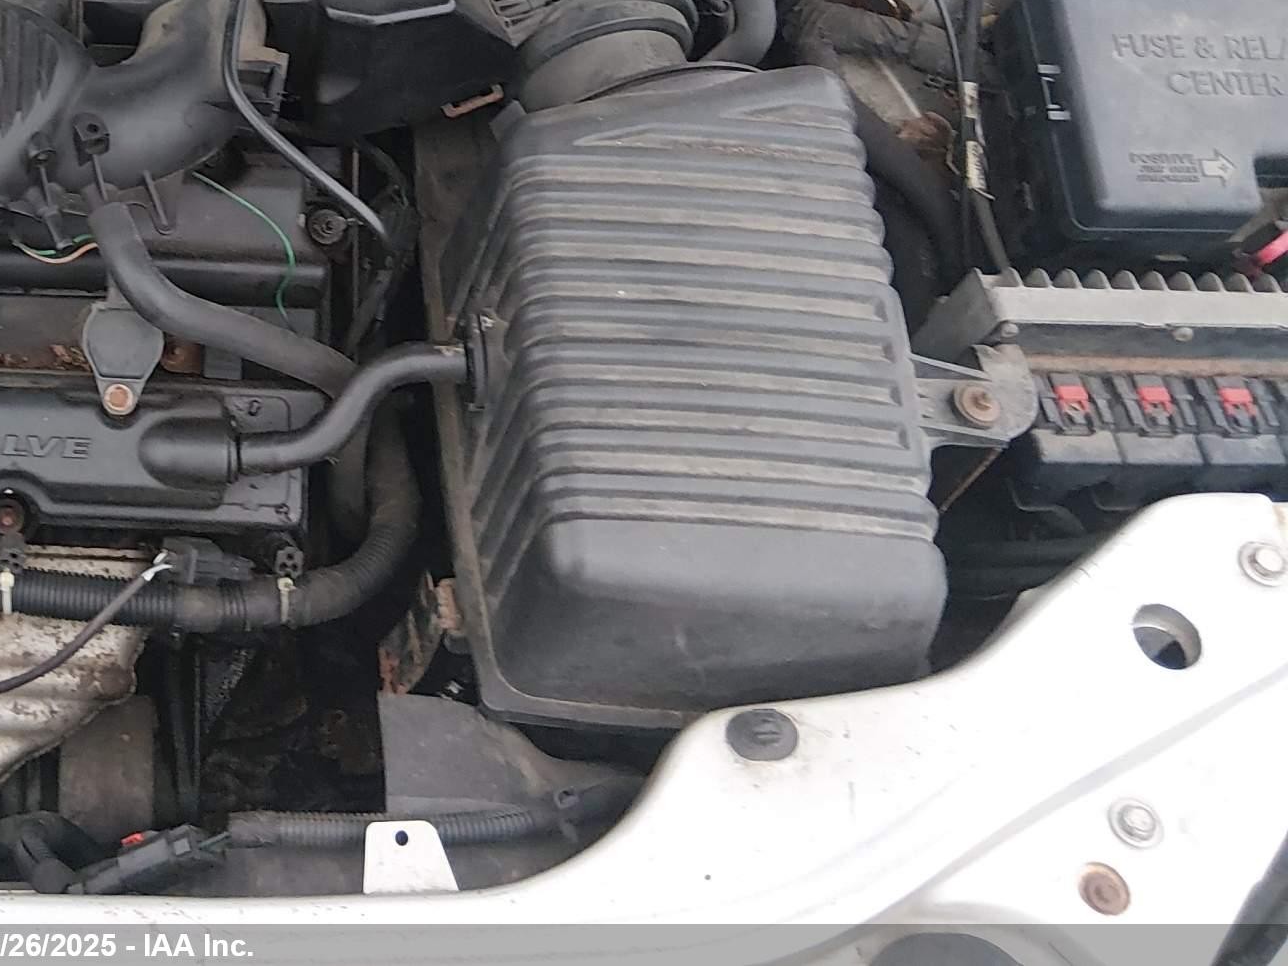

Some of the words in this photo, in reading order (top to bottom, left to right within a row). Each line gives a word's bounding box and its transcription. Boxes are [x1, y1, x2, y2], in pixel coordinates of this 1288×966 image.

[1112, 33, 1185, 58] FUSE
[1193, 35, 1217, 59] &
[1167, 70, 1285, 97] CENTER
